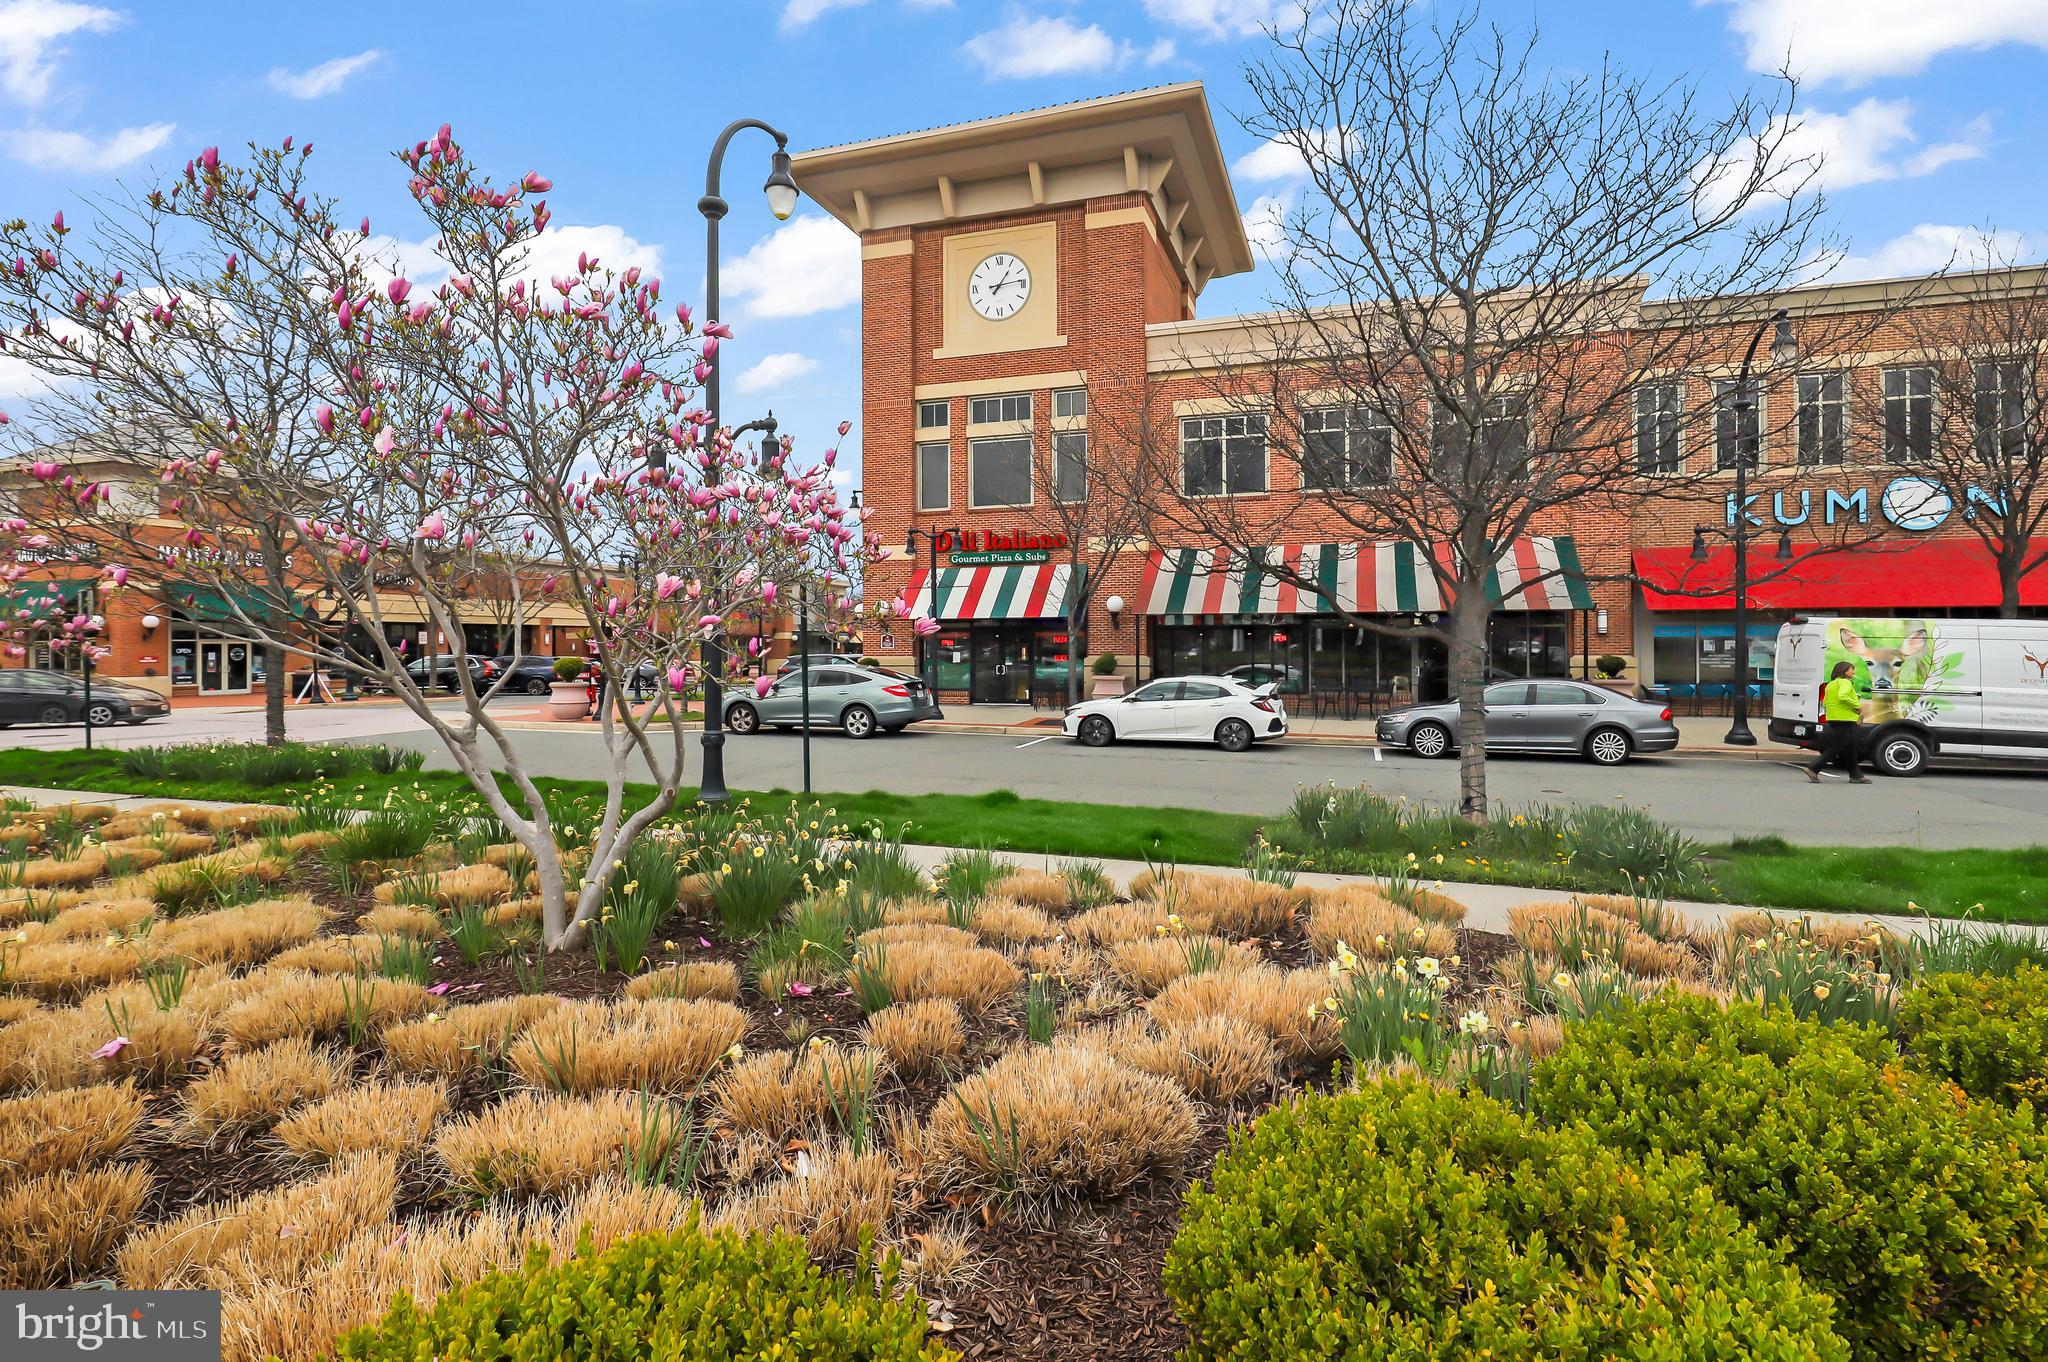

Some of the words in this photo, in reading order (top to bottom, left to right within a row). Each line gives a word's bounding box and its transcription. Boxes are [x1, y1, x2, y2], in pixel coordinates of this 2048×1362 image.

[995, 256, 1004, 266] XII
[972, 284, 979, 295] IX
[995, 307, 1003, 317] VI
[1726, 477, 2009, 530] KUMON
[936, 530, 977, 551] Dli
[983, 528, 1068, 550] Italiano
[951, 554, 989, 564] Gourmet
[991, 553, 1012, 562] Pizza
[1014, 553, 1023, 561] &
[1025, 551, 1046, 561] Subs
